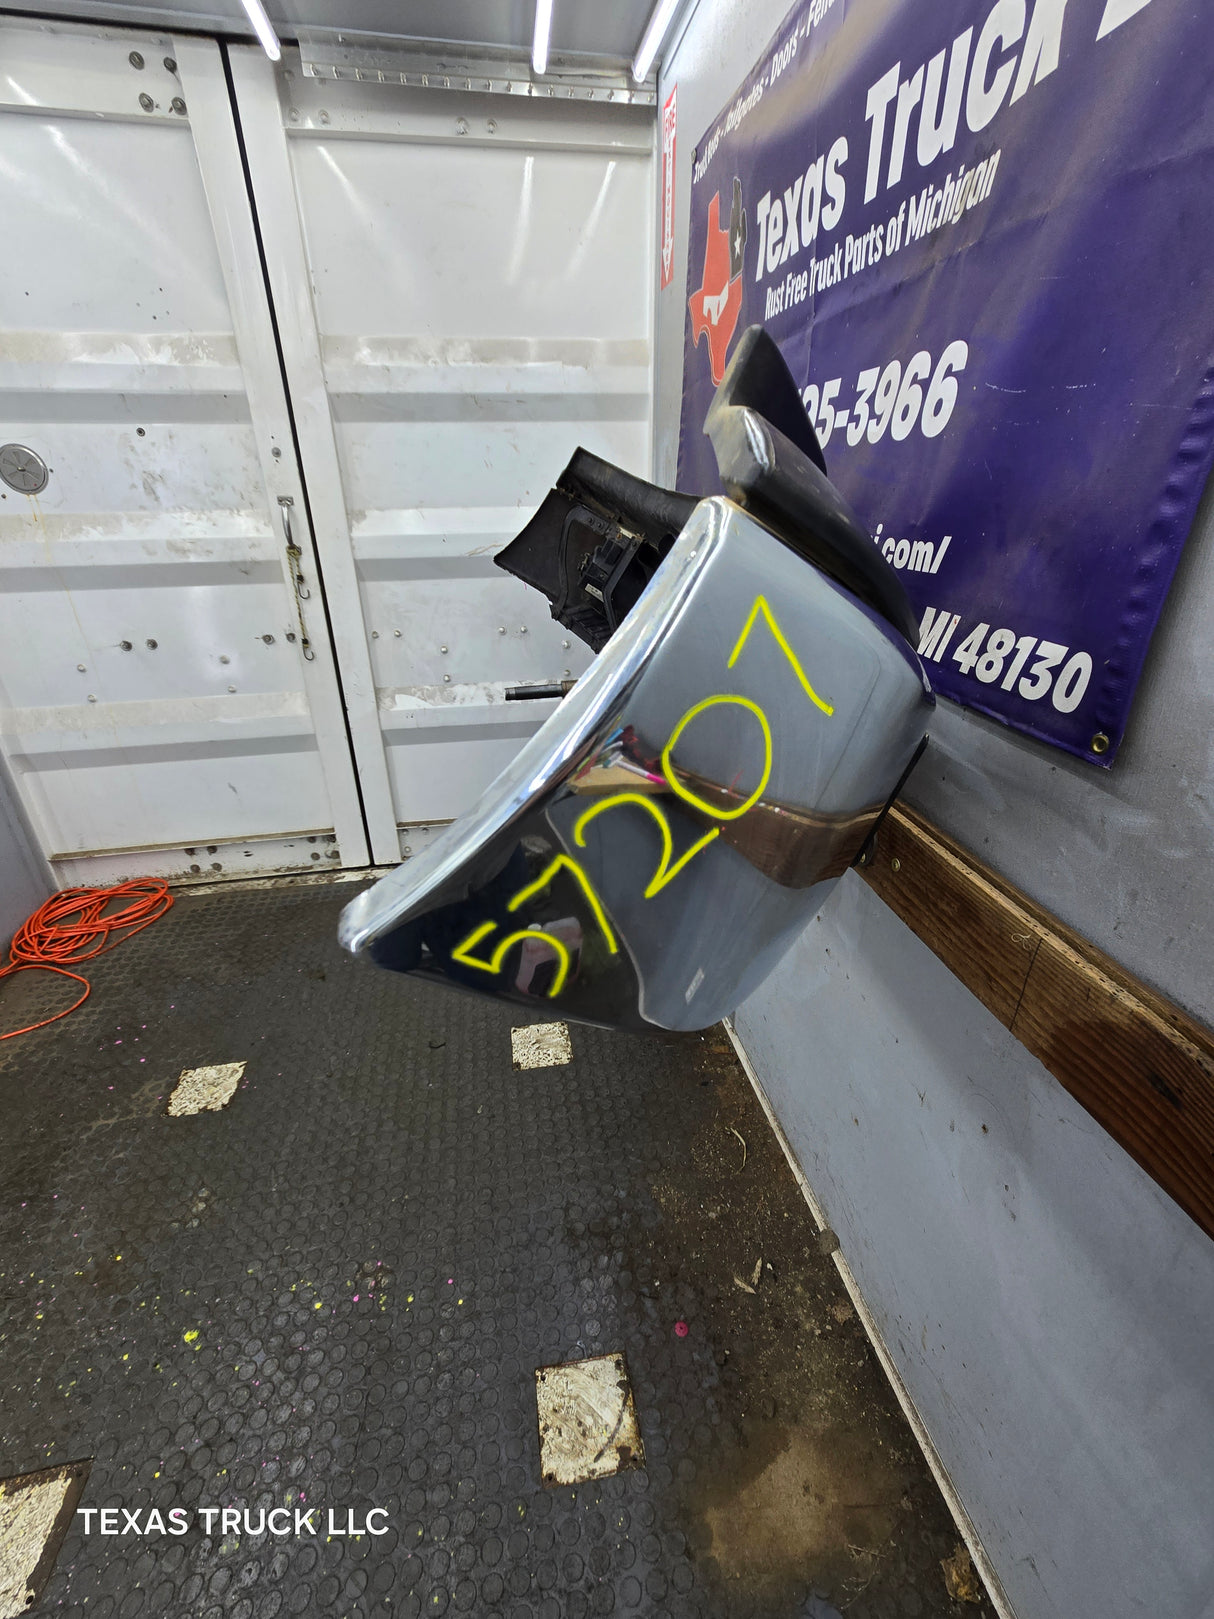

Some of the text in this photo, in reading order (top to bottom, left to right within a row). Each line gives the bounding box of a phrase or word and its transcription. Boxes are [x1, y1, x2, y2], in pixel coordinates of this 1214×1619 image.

[769, 27, 799, 87] Doors
[755, 136, 848, 283] Texas
[764, 148, 1001, 321] Rust Free Truck Parts of Michigan
[917, 606, 1093, 713] MI 48130
